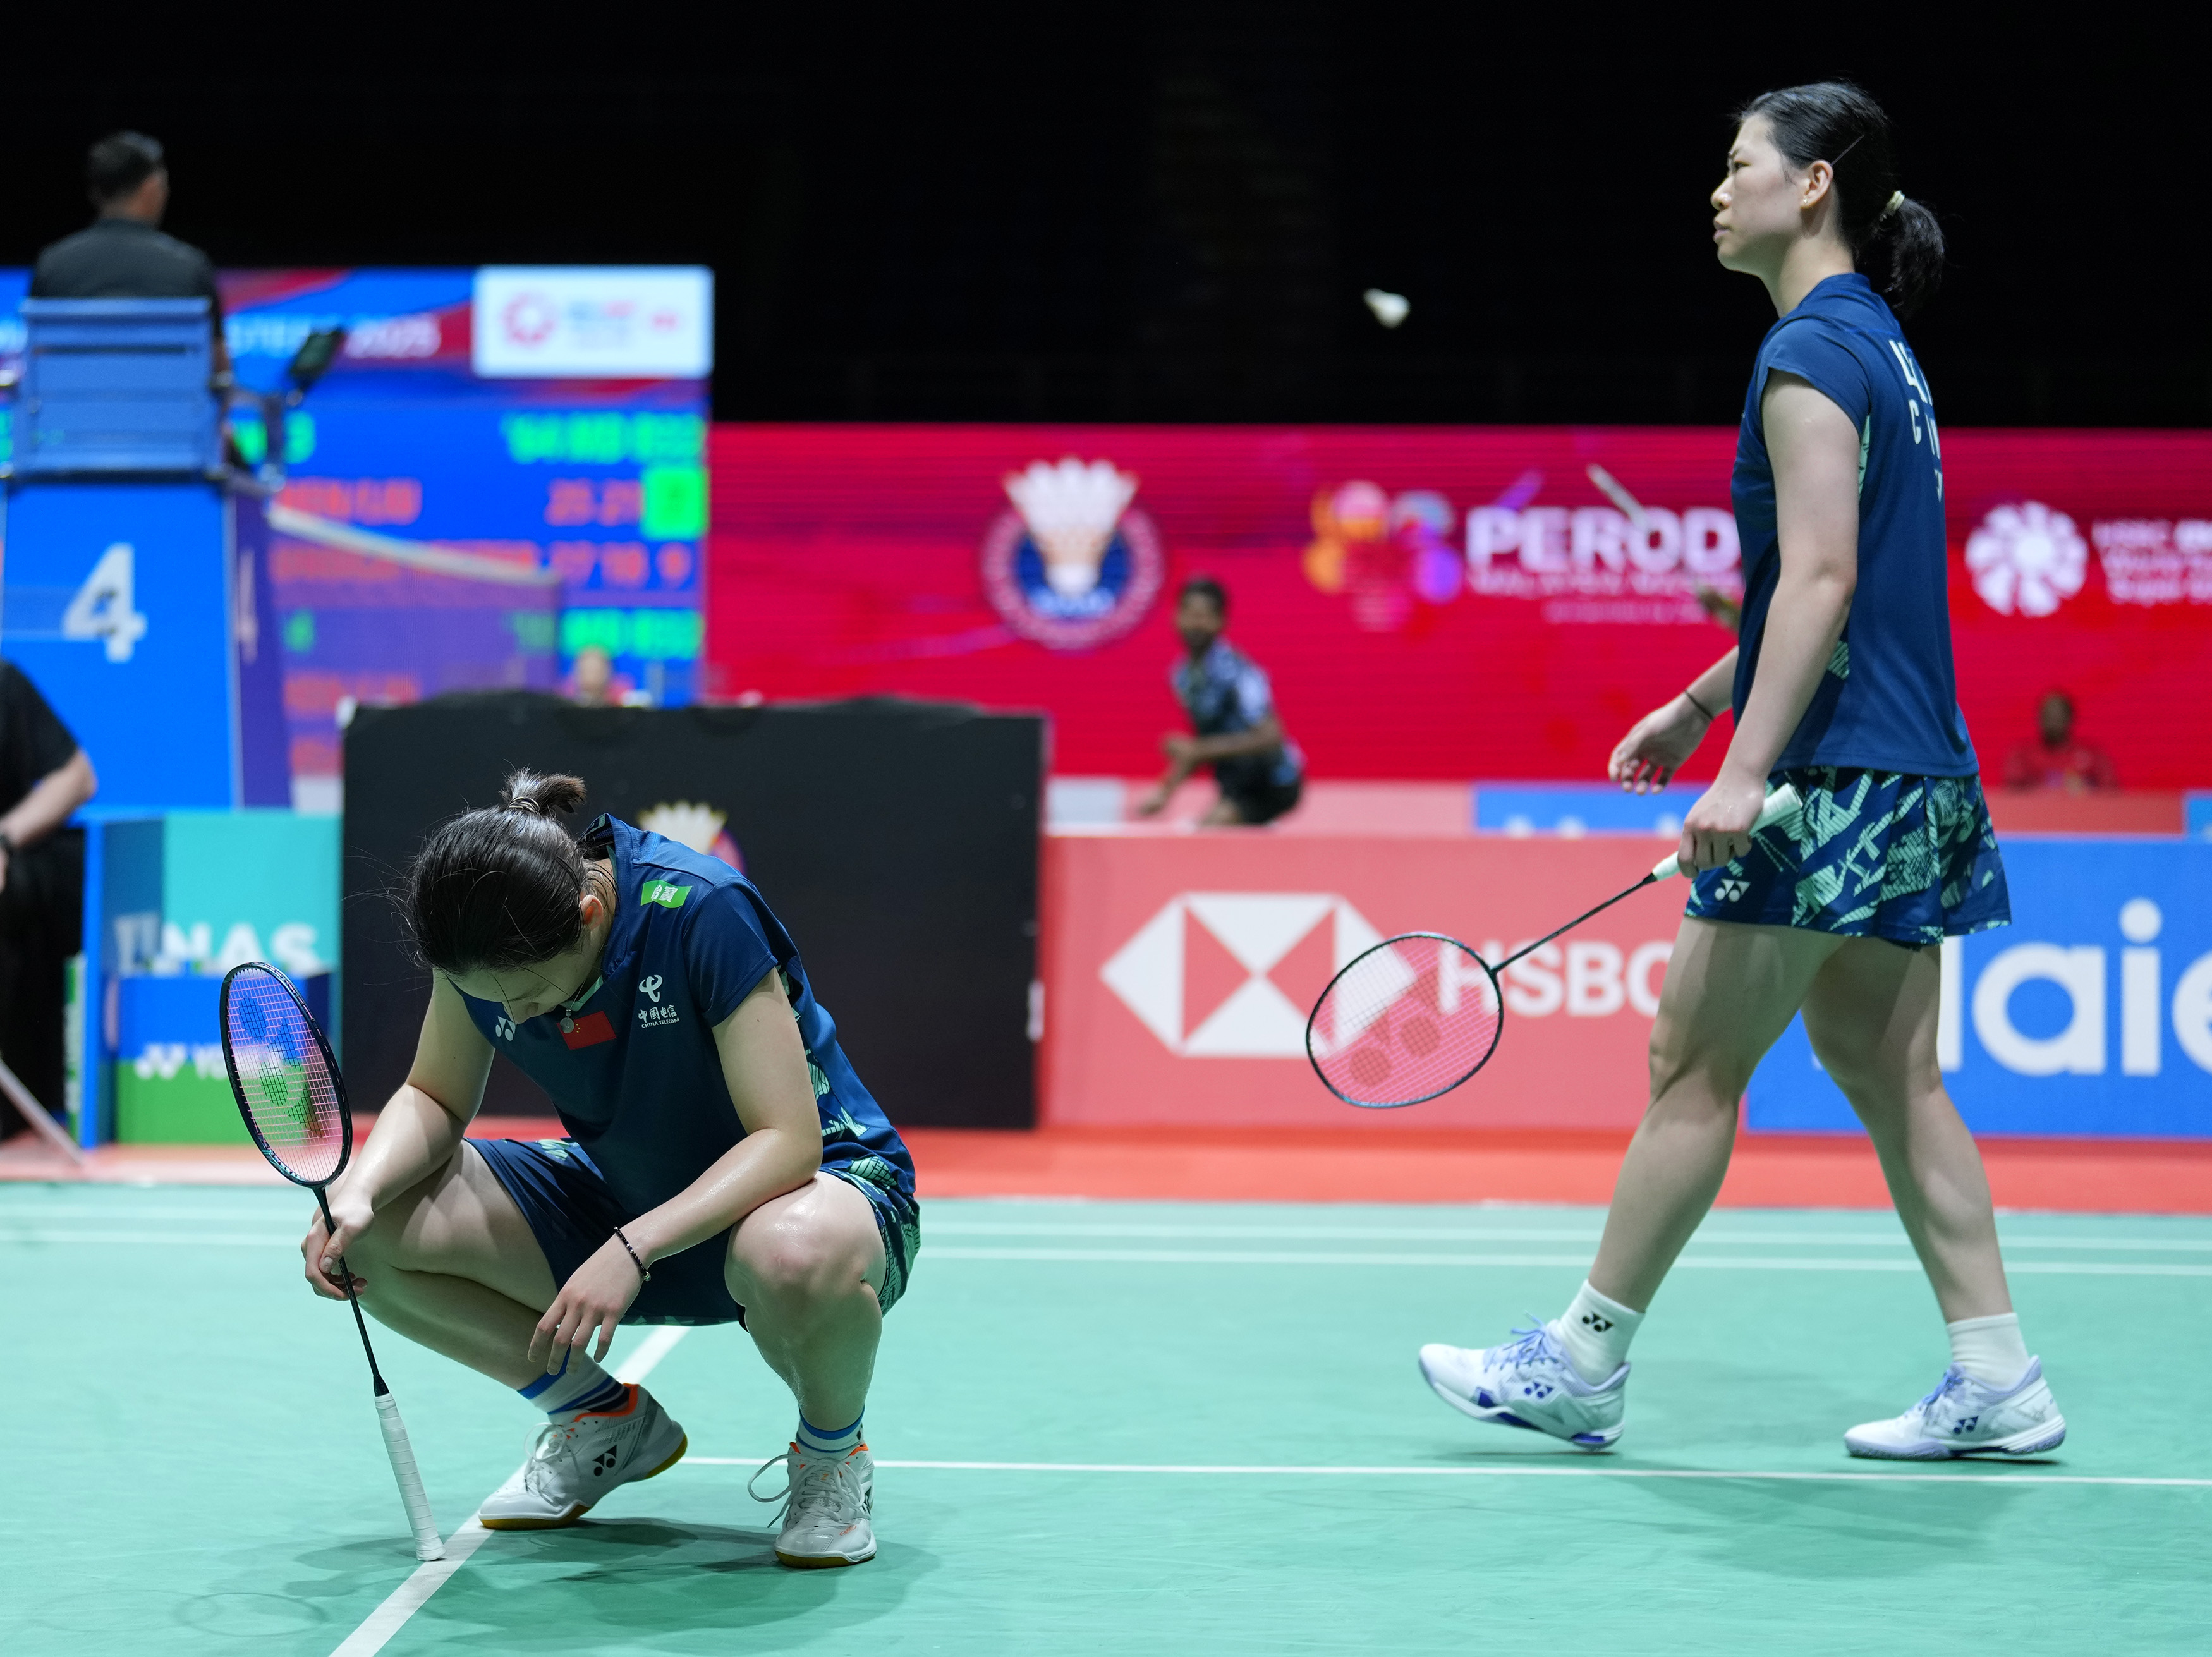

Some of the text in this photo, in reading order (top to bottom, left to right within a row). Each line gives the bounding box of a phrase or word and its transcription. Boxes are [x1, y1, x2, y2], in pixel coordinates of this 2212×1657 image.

[64, 542, 147, 663] 4
[1437, 938, 1674, 1017] HSBC
[638, 1004, 678, 1024] 中国电信
[641, 1017, 680, 1029] CHINA TELECOM
